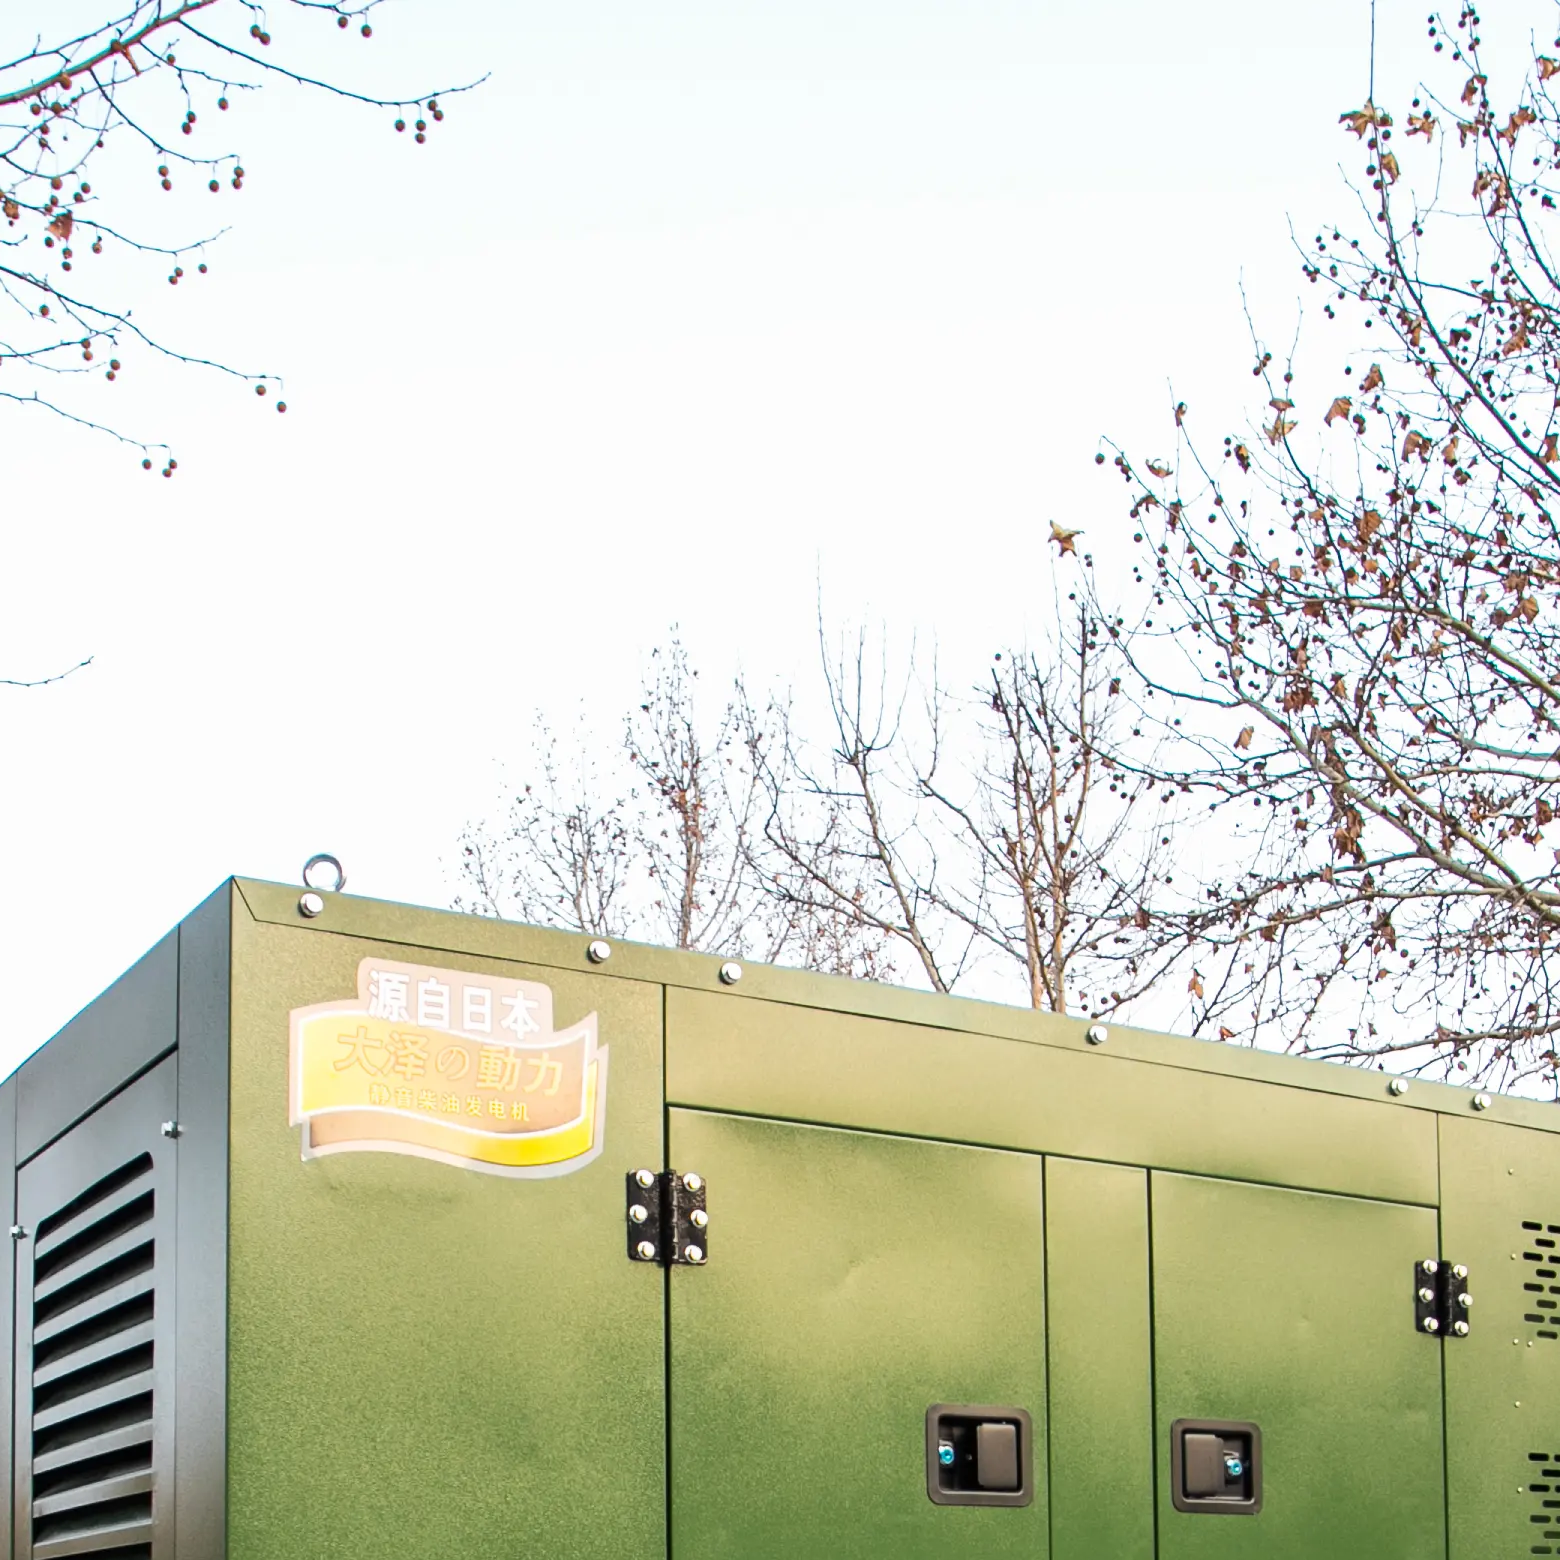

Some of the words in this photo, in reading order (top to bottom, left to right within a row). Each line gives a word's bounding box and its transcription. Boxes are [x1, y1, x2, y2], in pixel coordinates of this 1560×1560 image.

[368, 968, 541, 1041] 源自日本
[333, 1026, 565, 1097] 大泽の動力
[369, 1083, 531, 1122] 静音柴油发电机
